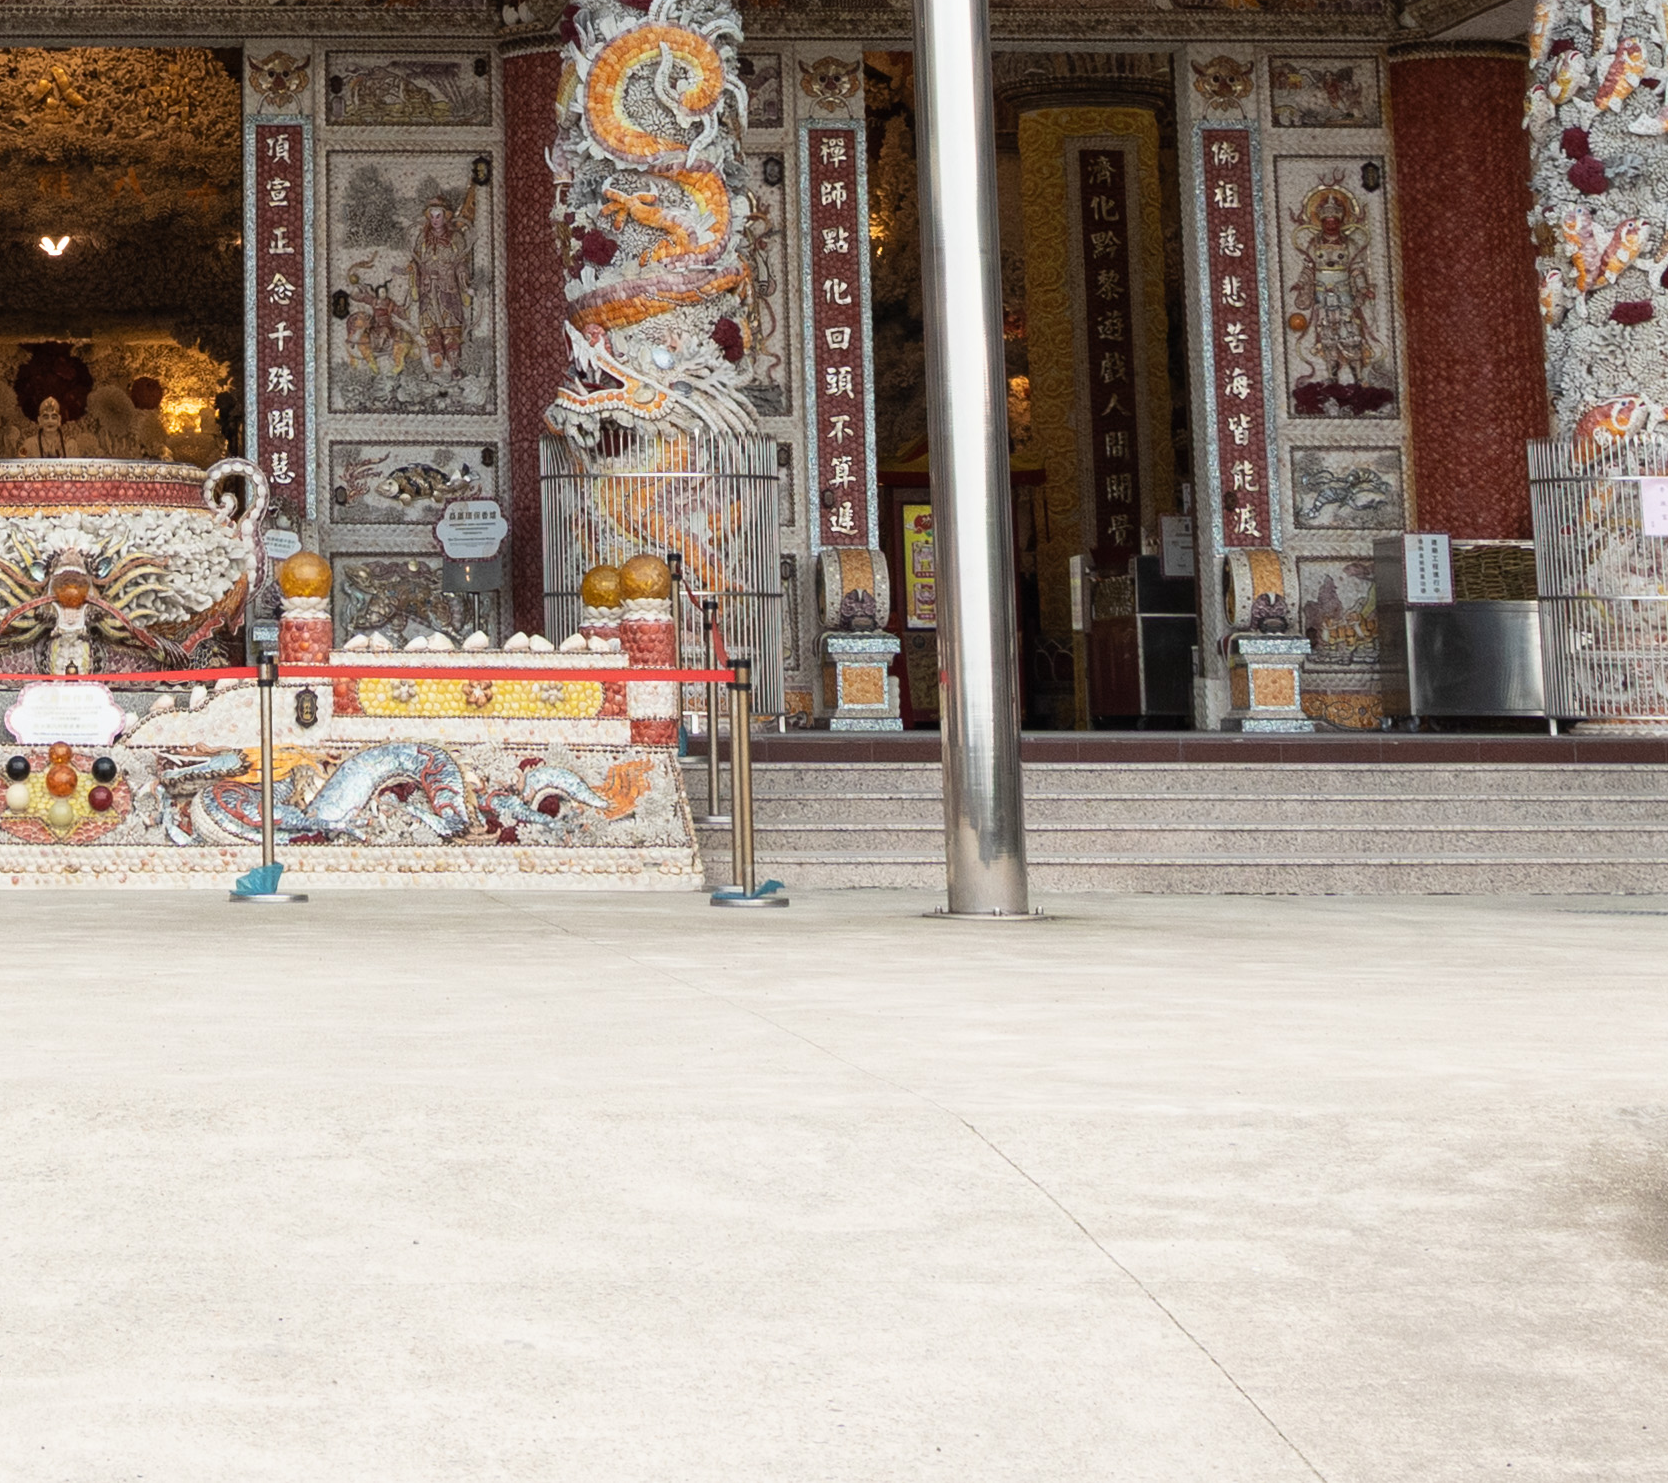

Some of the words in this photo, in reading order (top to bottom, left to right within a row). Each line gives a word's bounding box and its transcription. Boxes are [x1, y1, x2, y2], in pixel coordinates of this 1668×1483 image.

[819, 137, 859, 536] 禪師點化回頭不算遲
[1210, 141, 1262, 538] 佛祖慈悲苦海皆能渡
